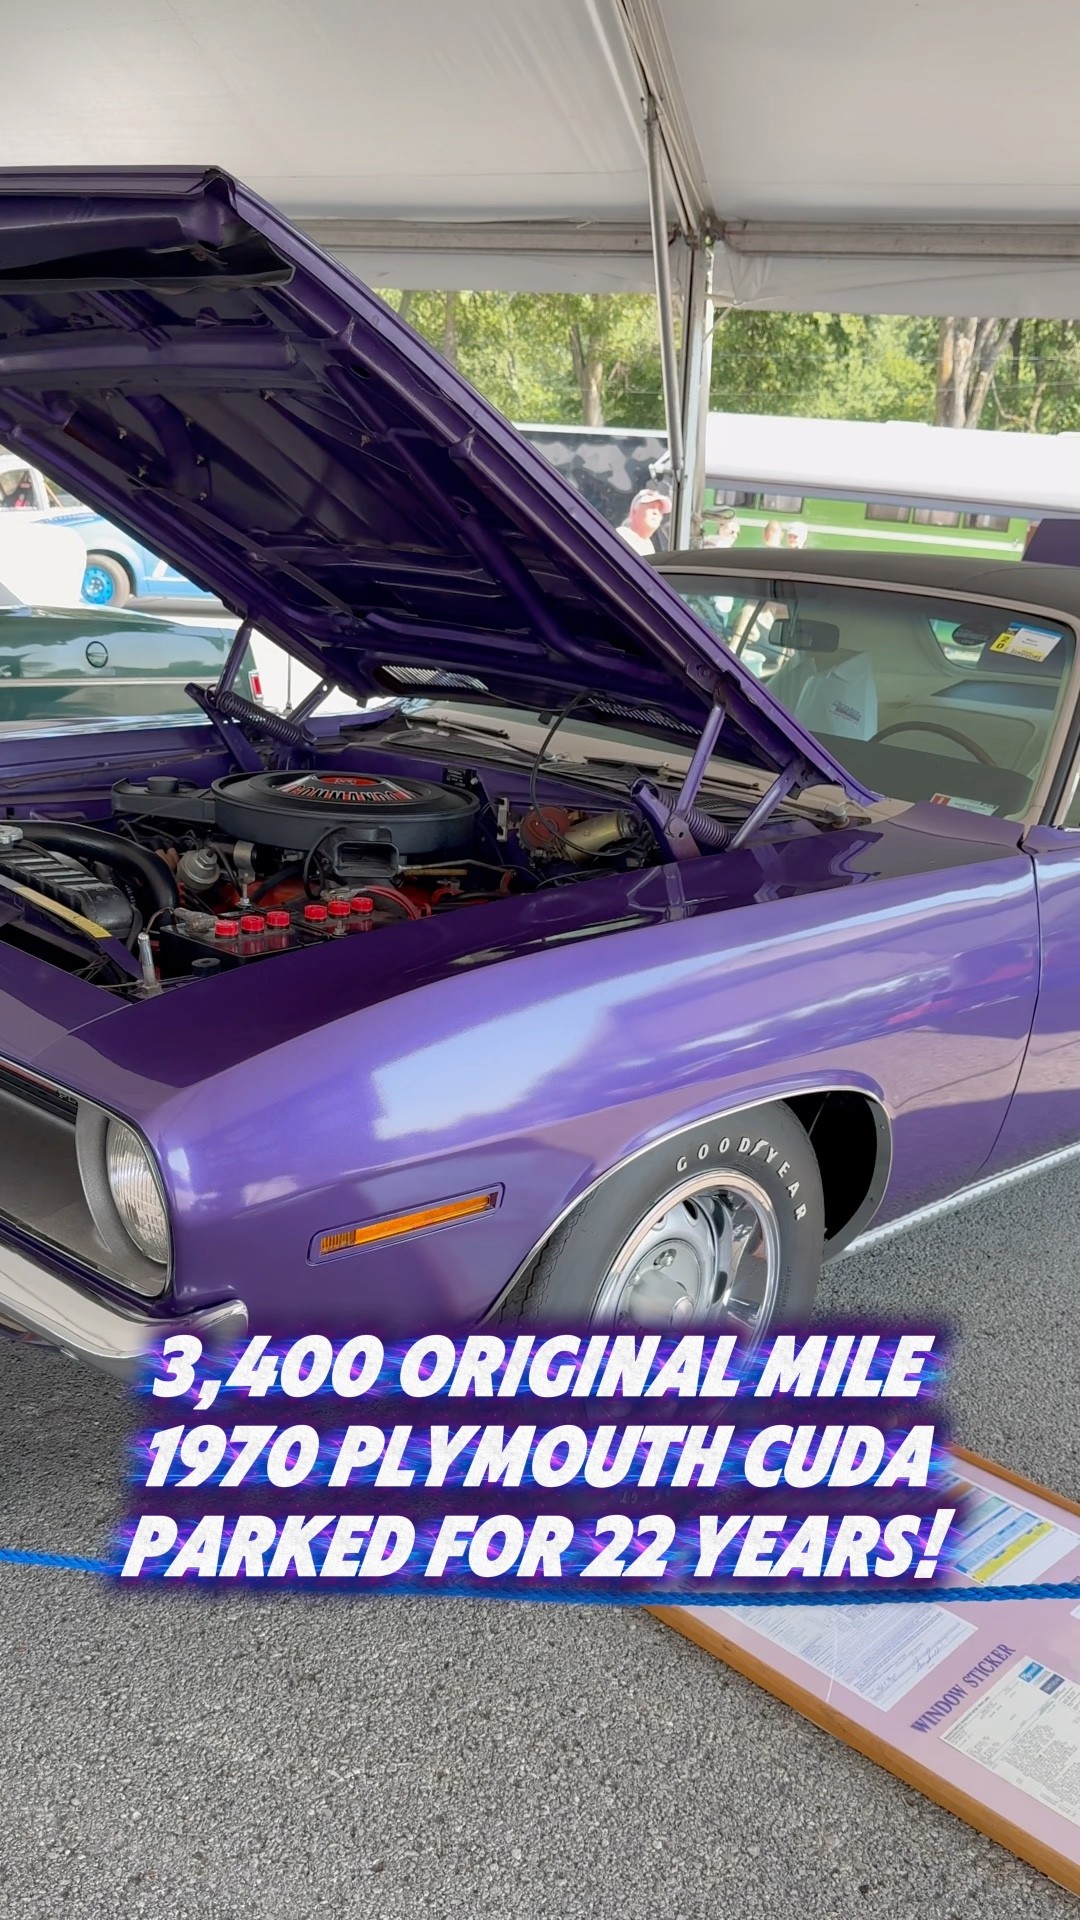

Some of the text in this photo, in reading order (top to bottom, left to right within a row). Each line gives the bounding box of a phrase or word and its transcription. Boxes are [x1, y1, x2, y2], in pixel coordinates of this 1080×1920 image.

[676, 1137, 807, 1221] GOODYEAR
[910, 1683, 969, 1734] WINDOW
[962, 1643, 1017, 1689] STICKER
